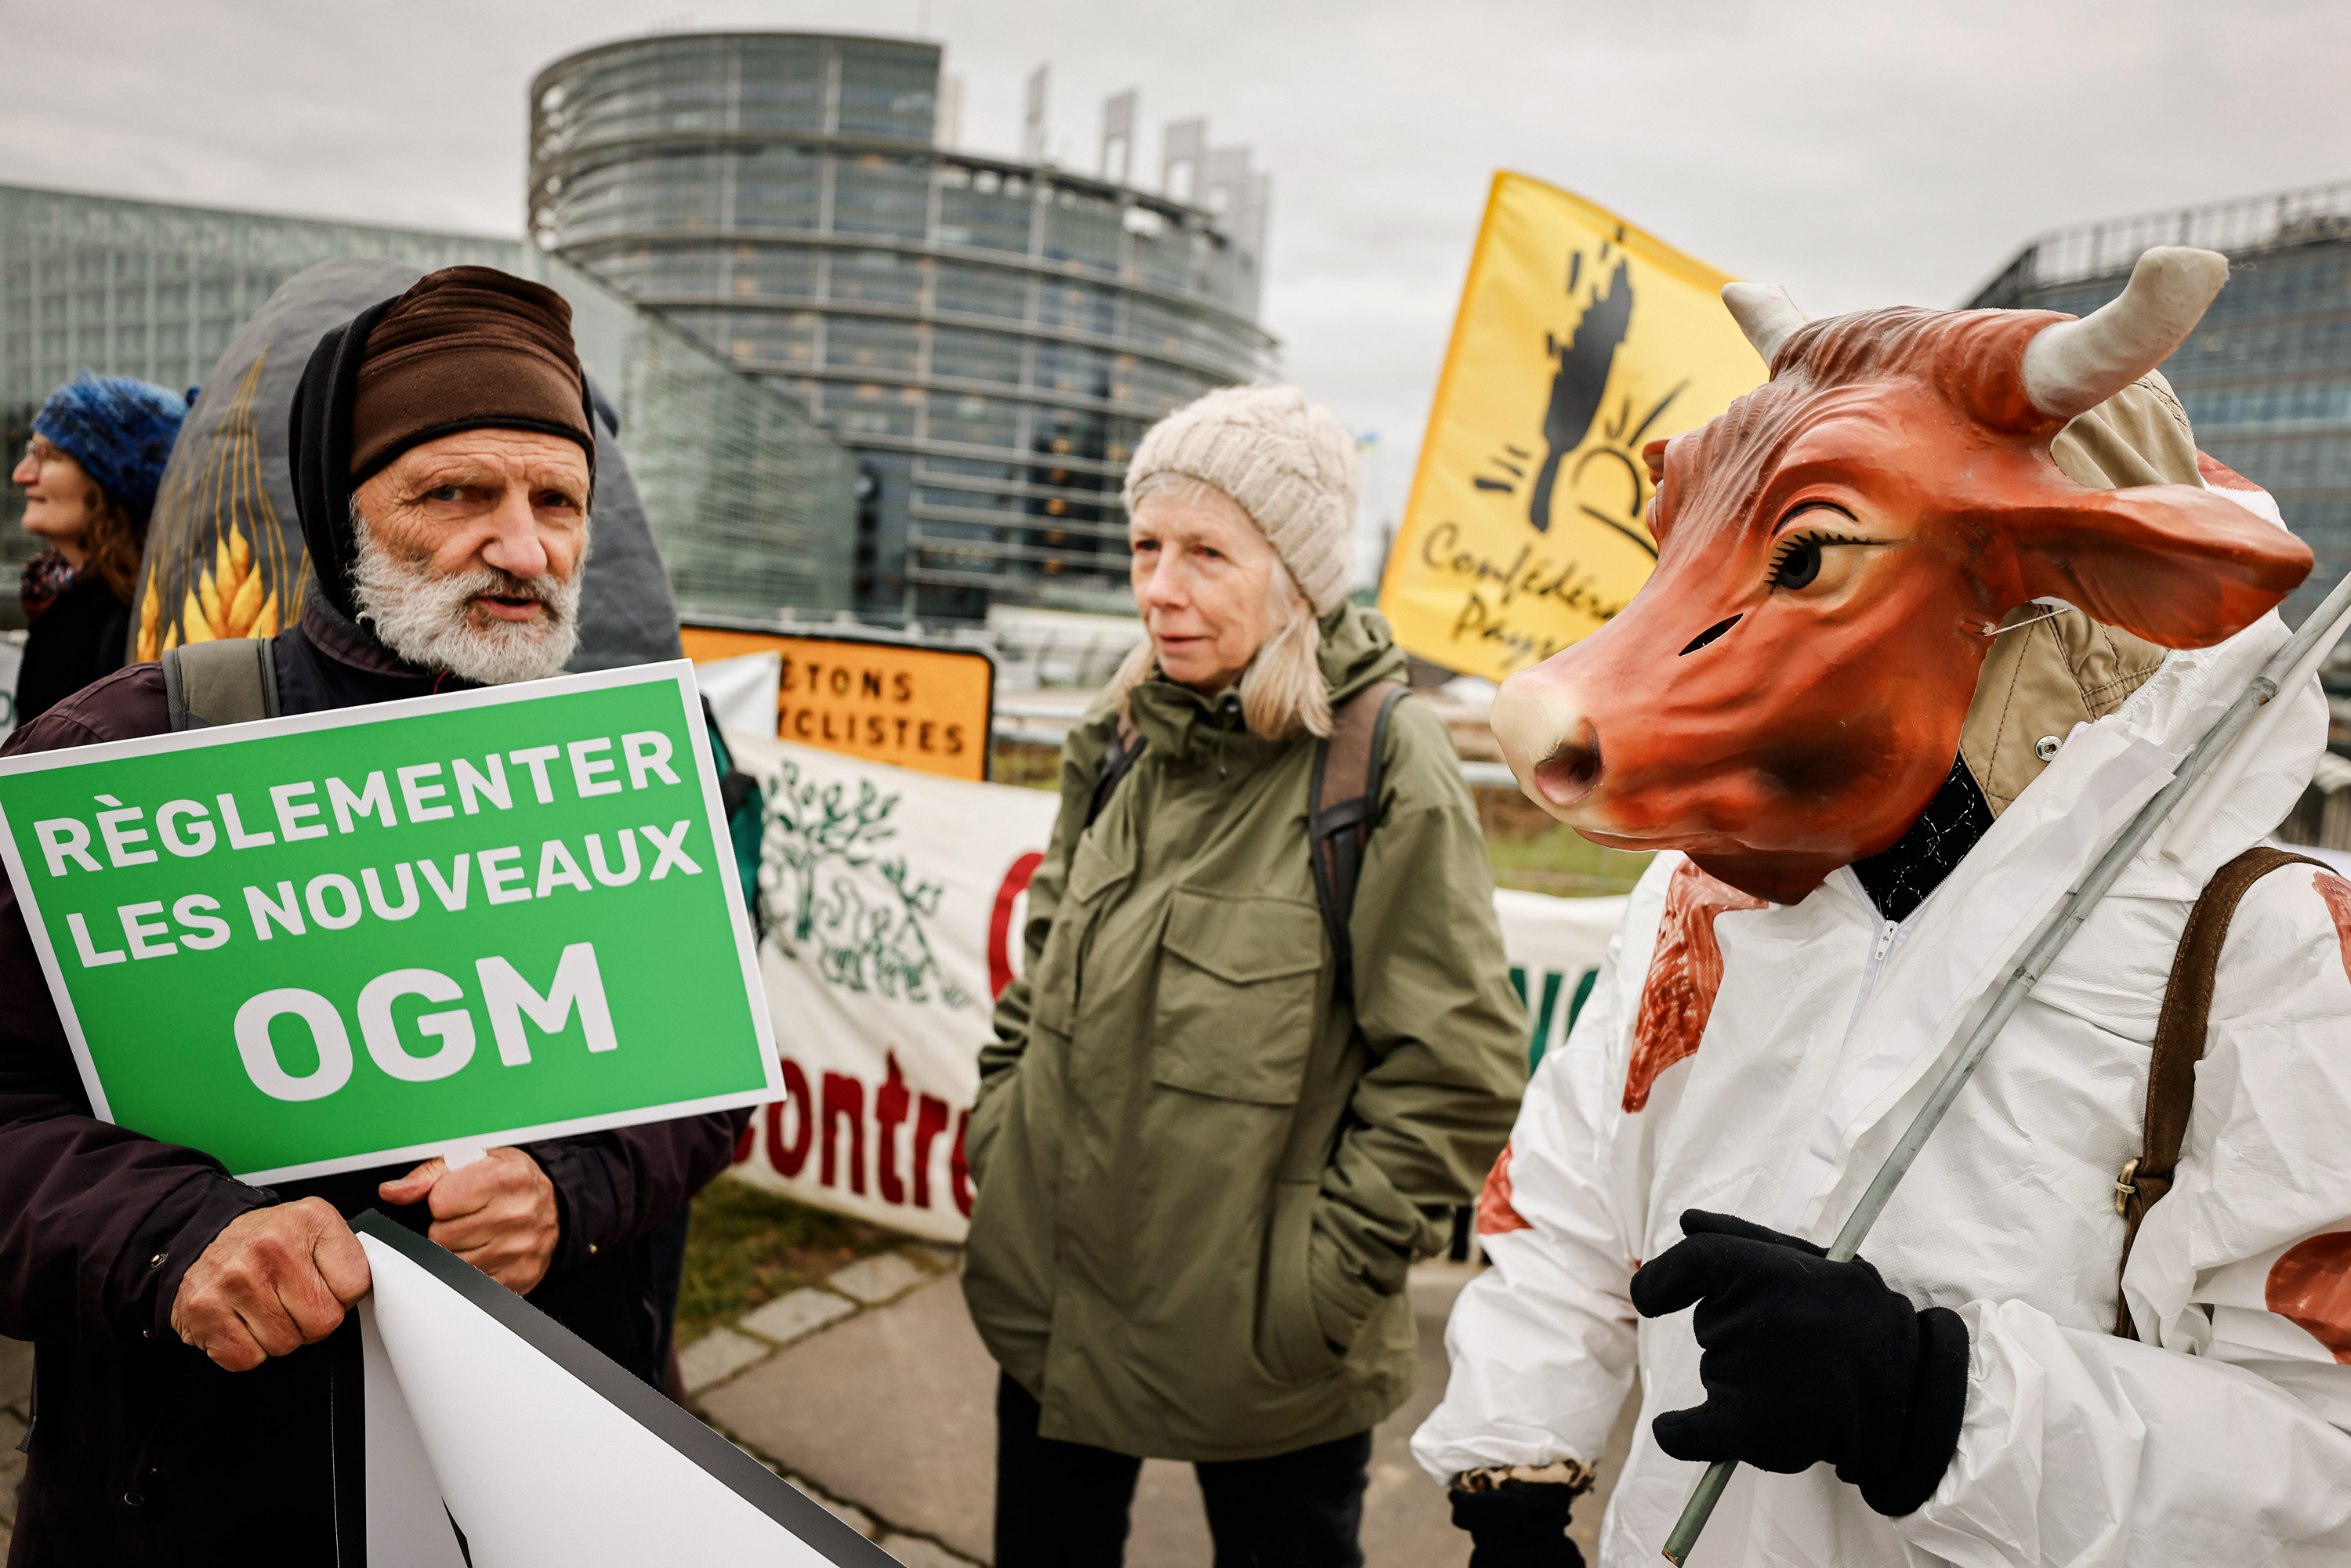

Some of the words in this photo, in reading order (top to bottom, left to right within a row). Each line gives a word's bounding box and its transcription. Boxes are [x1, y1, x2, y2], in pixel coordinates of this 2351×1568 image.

[33, 730, 682, 877] RÈGLEMENTER
[66, 893, 231, 968] LES
[242, 819, 704, 941] NOUVEAUX
[234, 941, 618, 1102] OGM
[732, 1045, 974, 1220] ontr
